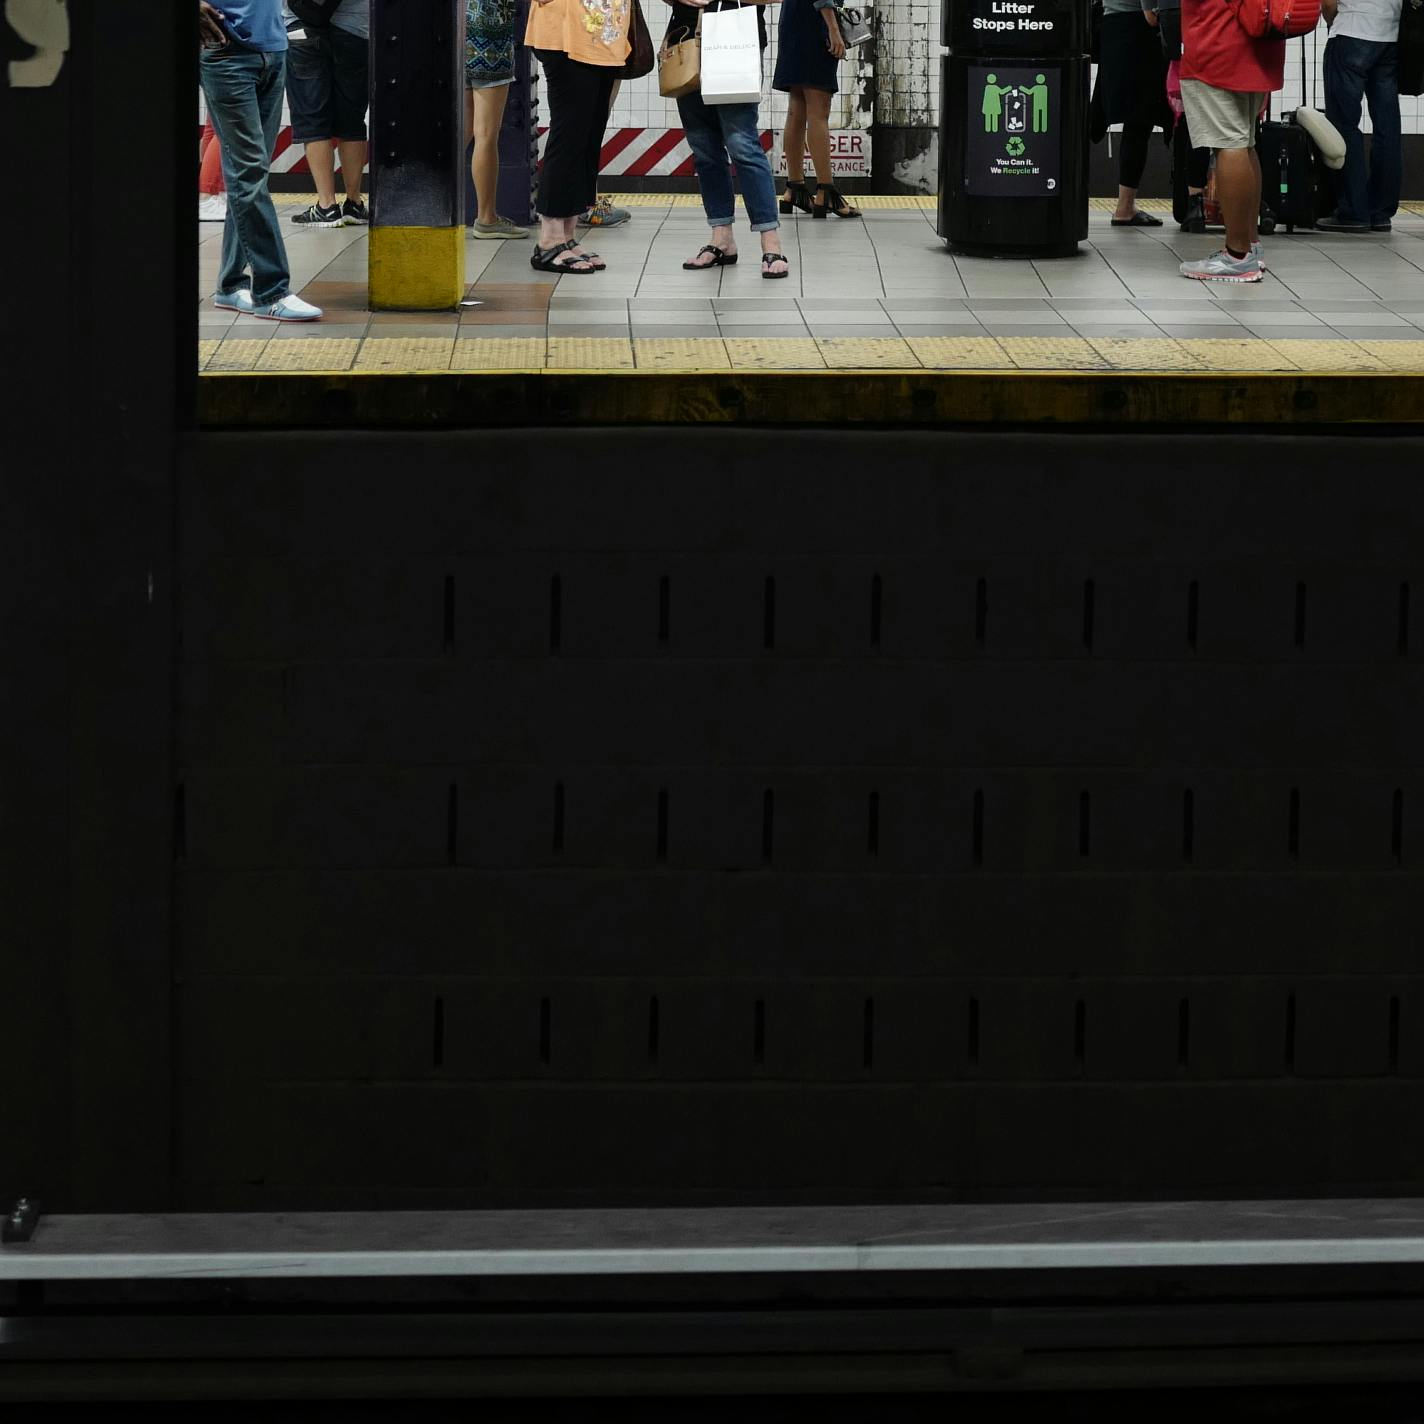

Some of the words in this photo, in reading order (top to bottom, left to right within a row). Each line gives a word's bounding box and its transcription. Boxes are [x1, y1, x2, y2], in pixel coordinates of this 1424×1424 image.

[991, 2, 1035, 14] Litter
[972, 17, 1015, 33] Stops
[1018, 18, 1054, 30] Here
[996, 158, 1010, 166] You
[1010, 158, 1025, 166] Can
[1002, 167, 1031, 175] Recycle
